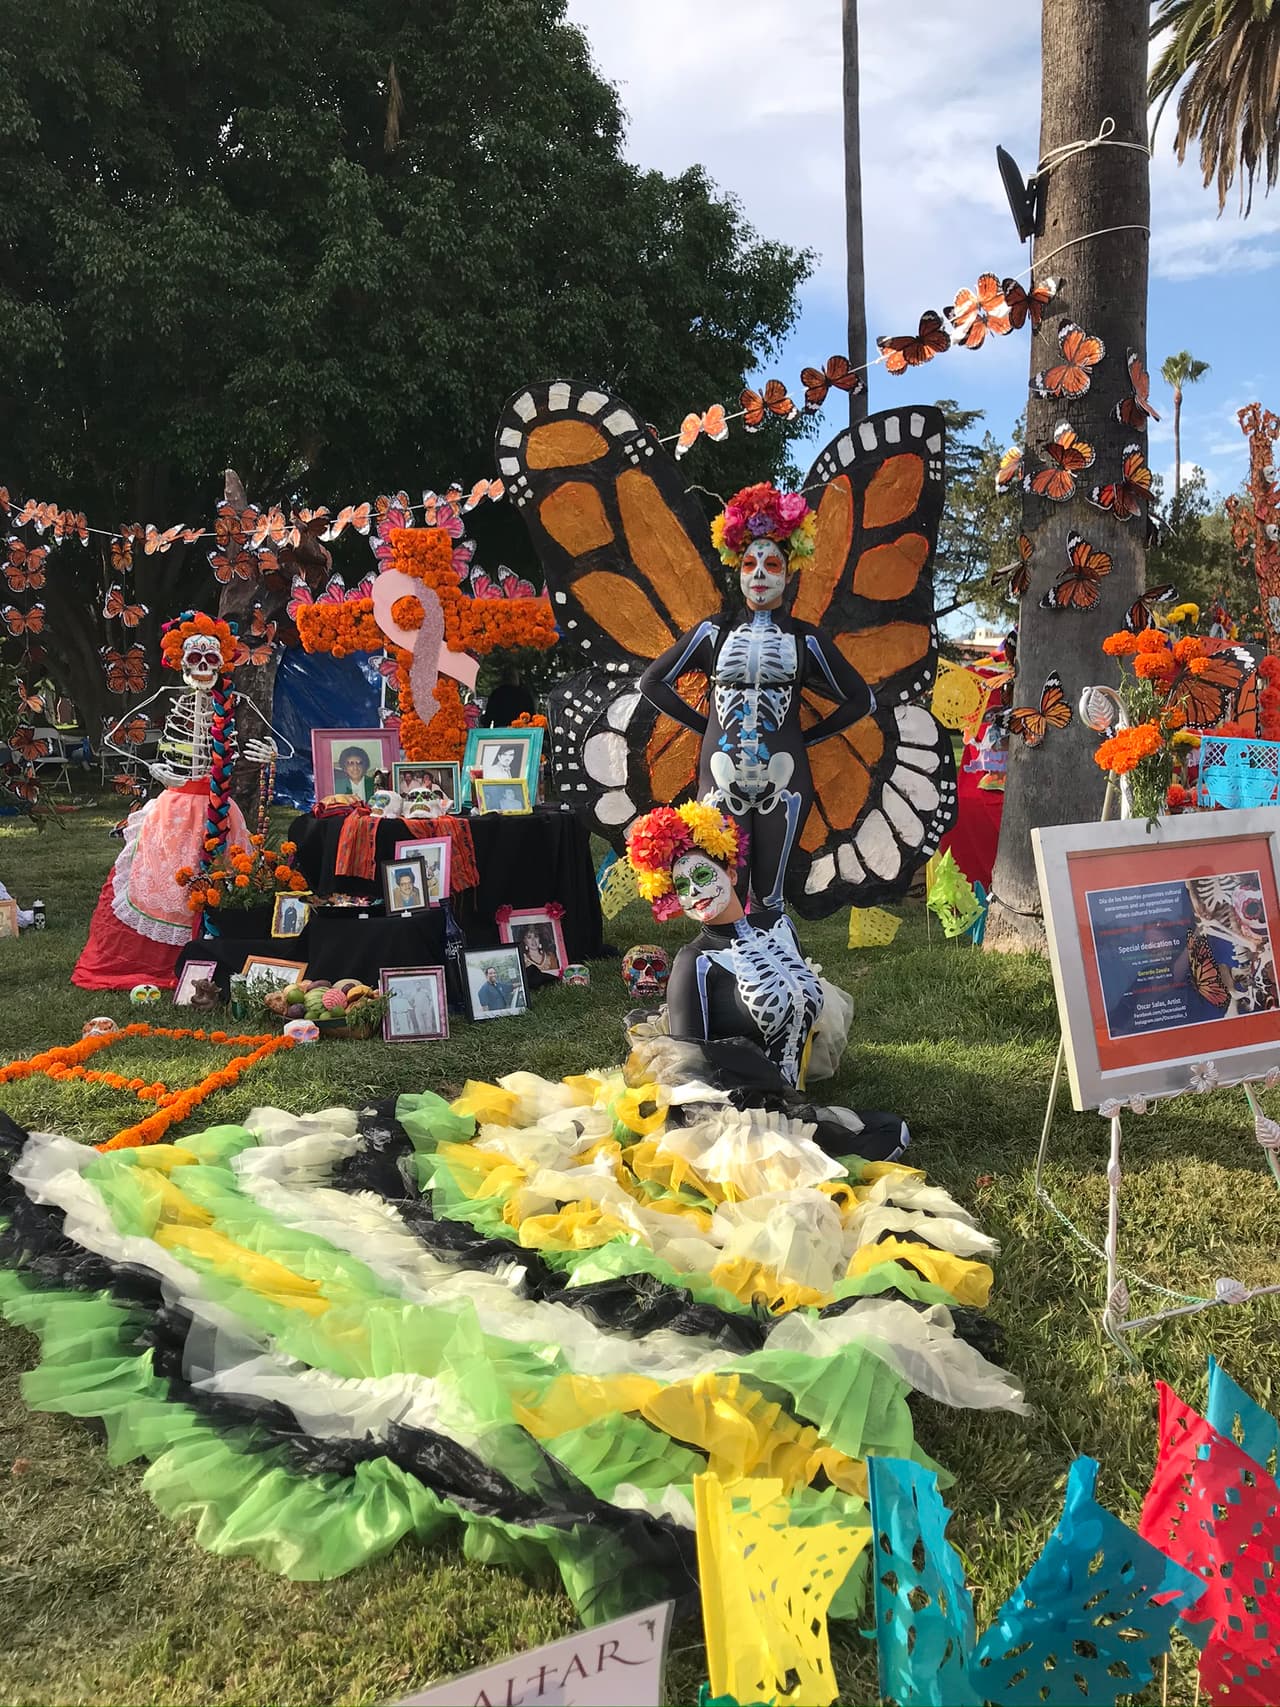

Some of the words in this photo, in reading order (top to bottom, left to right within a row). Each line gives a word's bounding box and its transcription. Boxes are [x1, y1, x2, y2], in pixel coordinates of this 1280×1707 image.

[1118, 944, 1140, 954] Special
[1140, 939, 1173, 950] dedication
[473, 1639, 655, 1707] ALTAR
